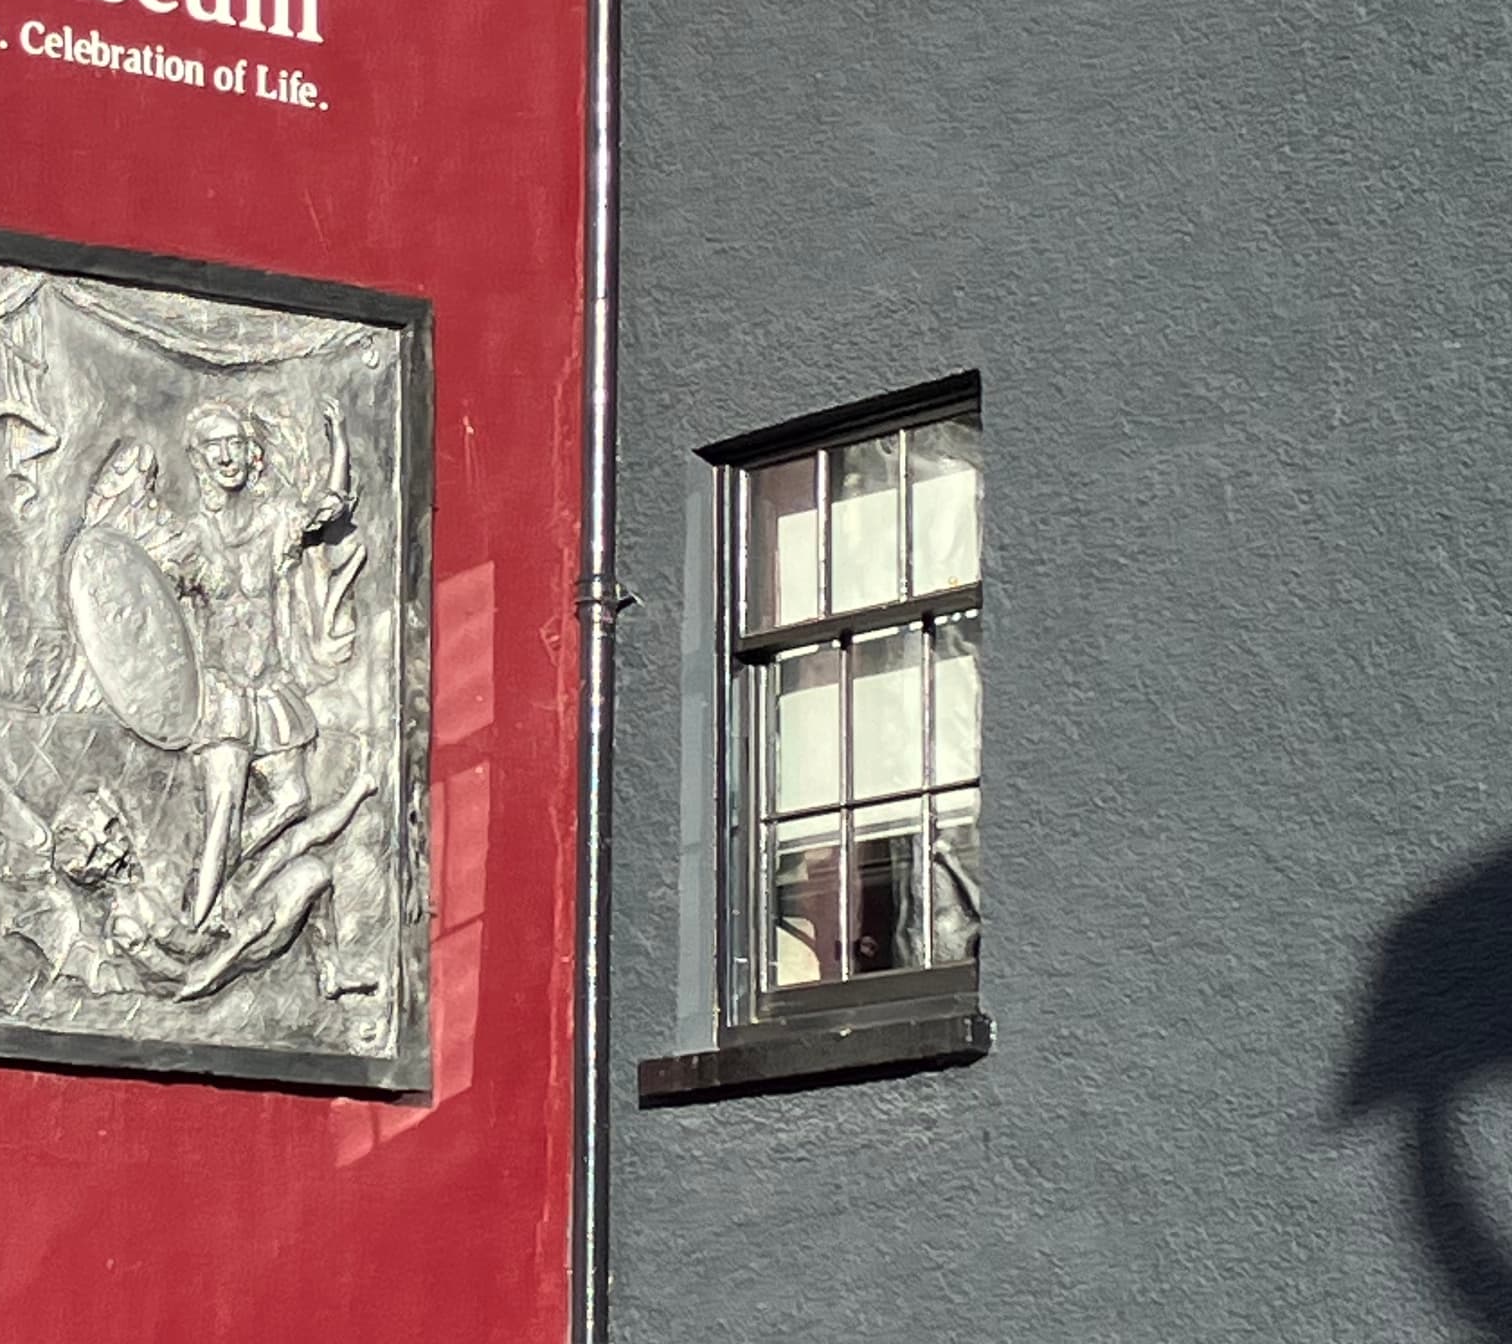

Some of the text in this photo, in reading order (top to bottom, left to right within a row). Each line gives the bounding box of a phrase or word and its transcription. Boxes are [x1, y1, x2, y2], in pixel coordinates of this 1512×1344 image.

[19, 20, 205, 87] Celebration
[213, 58, 248, 94] of
[255, 64, 329, 111] Life.
